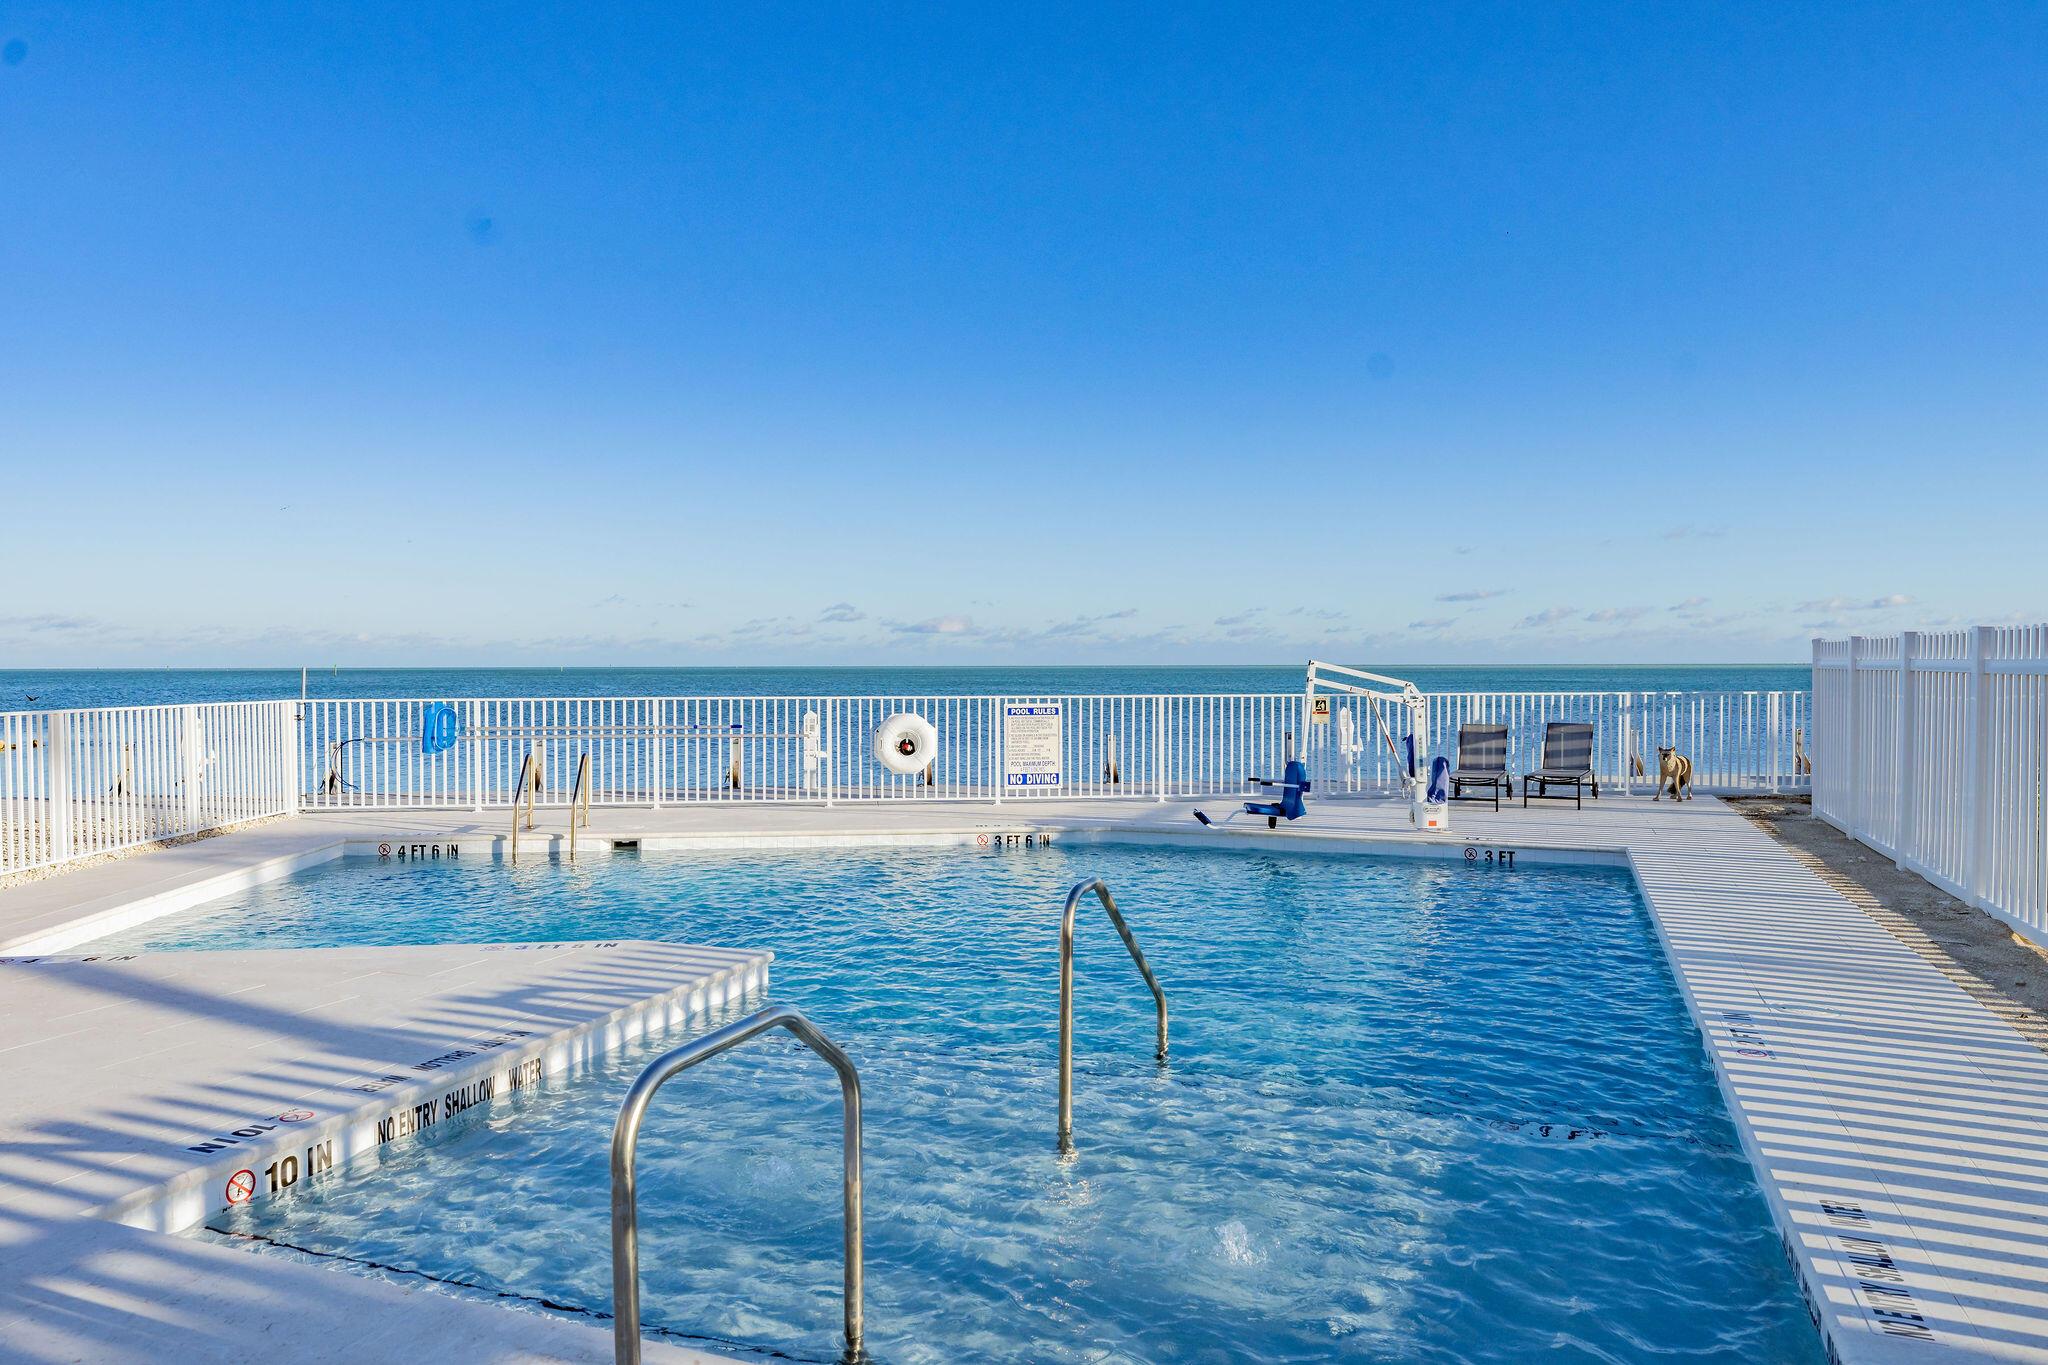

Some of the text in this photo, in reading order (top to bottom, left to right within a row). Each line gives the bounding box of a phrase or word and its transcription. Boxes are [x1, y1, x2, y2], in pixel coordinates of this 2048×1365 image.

[1010, 774, 1057, 785] NO DIVING
[397, 844, 459, 860] 4 FT 6 IN
[994, 834, 1050, 848] 3 FT 6 IN
[1485, 850, 1515, 867] 3 FT
[377, 1057, 542, 1145] NO ENTRY SHALLOW WATER
[187, 1124, 278, 1153] 10 IN
[264, 1139, 333, 1194] 10 IN
[1819, 1199, 1936, 1341] NO ENTRY SHALLOW WATER
